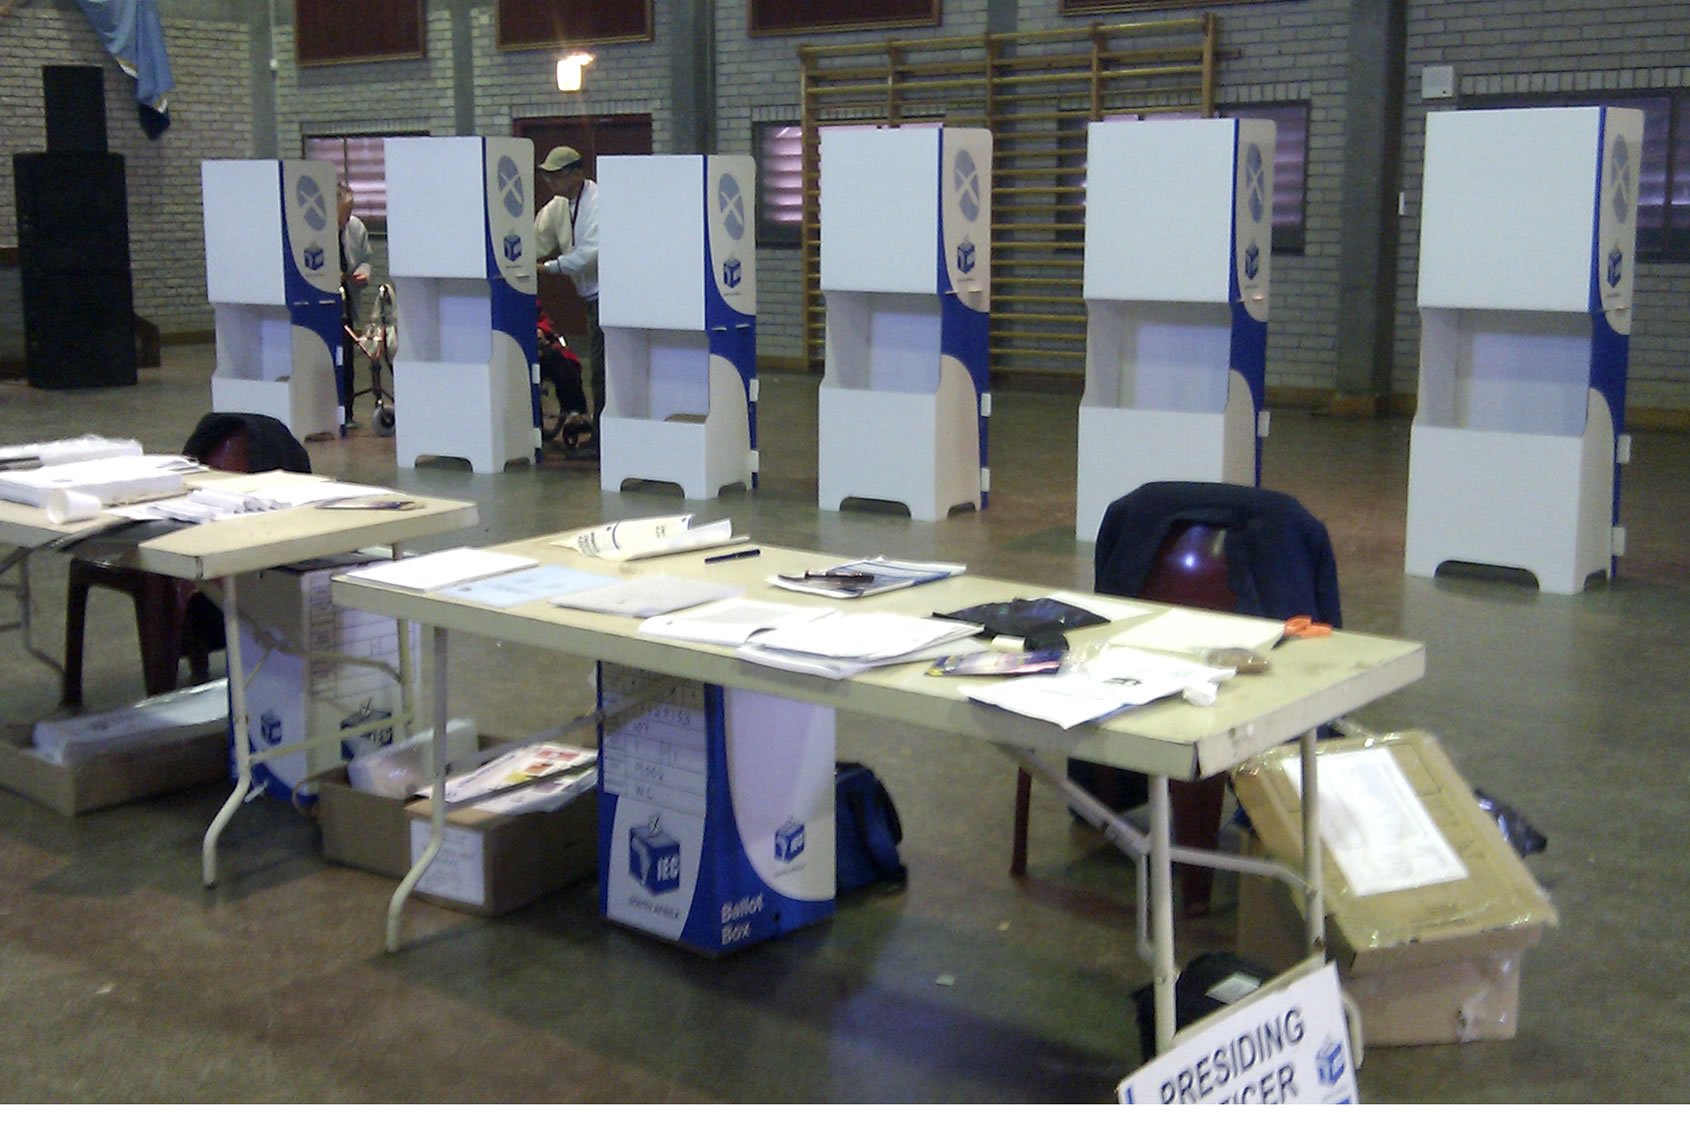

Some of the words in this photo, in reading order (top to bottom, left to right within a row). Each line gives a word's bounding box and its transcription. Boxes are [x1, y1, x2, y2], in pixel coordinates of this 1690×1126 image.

[721, 893, 763, 923] Ballot
[721, 922, 751, 945] Box
[1160, 1007, 1305, 1104] PRESIDING
